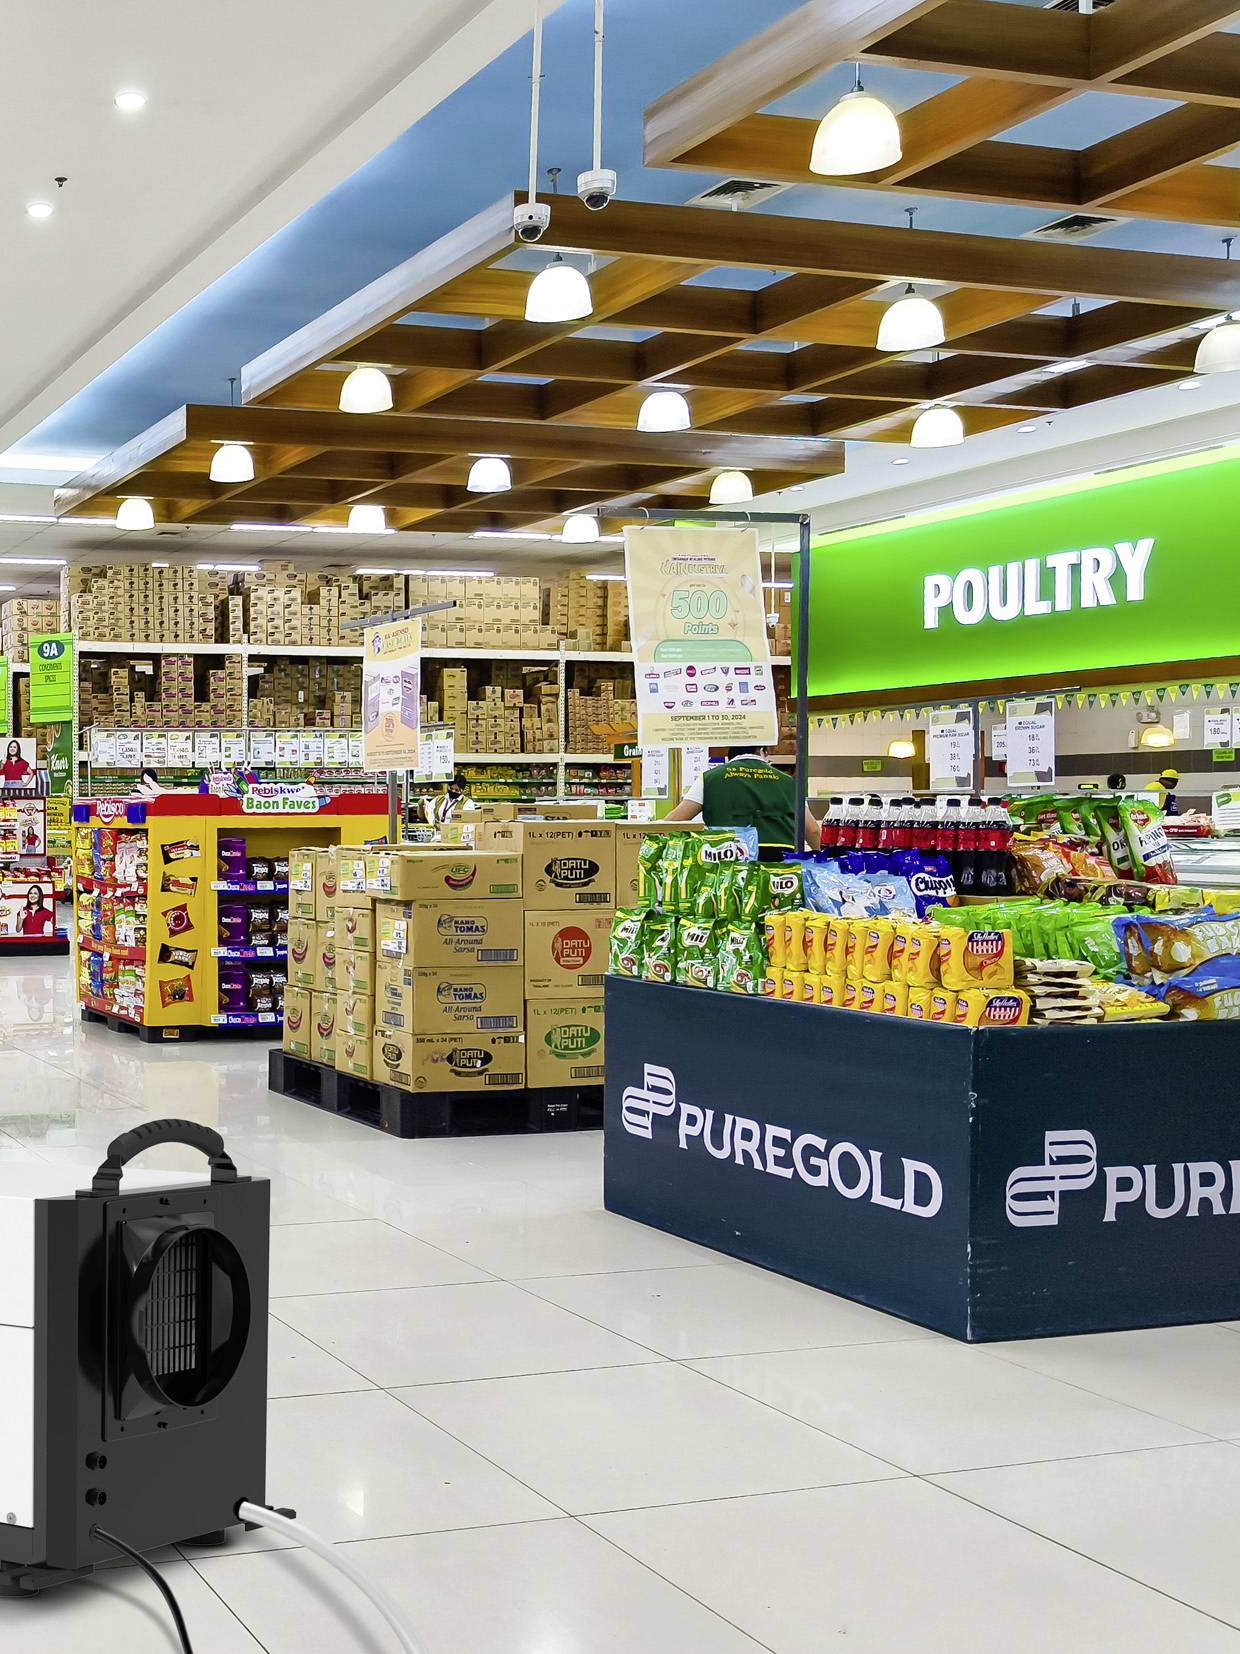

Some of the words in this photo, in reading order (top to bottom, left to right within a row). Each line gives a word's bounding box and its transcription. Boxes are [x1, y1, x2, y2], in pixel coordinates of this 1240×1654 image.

[923, 538, 1156, 630] POULTRY
[671, 590, 727, 619] 500
[684, 622, 719, 634] Points
[43, 643, 58, 657] 9A
[246, 797, 279, 809] Baon
[282, 797, 316, 809] Faves
[546, 831, 574, 839] 12(PET)
[704, 848, 734, 861] MILO
[561, 860, 589, 869] DATU
[561, 870, 583, 878] PUTI
[454, 925, 486, 933] TOMAS
[455, 937, 483, 945] Around
[563, 949, 585, 957] PUTI
[453, 992, 484, 1001] TOMAS
[561, 1027, 590, 1037] DATU
[561, 1038, 585, 1049] PUTI
[678, 1102, 943, 1218] PUREGOLD
